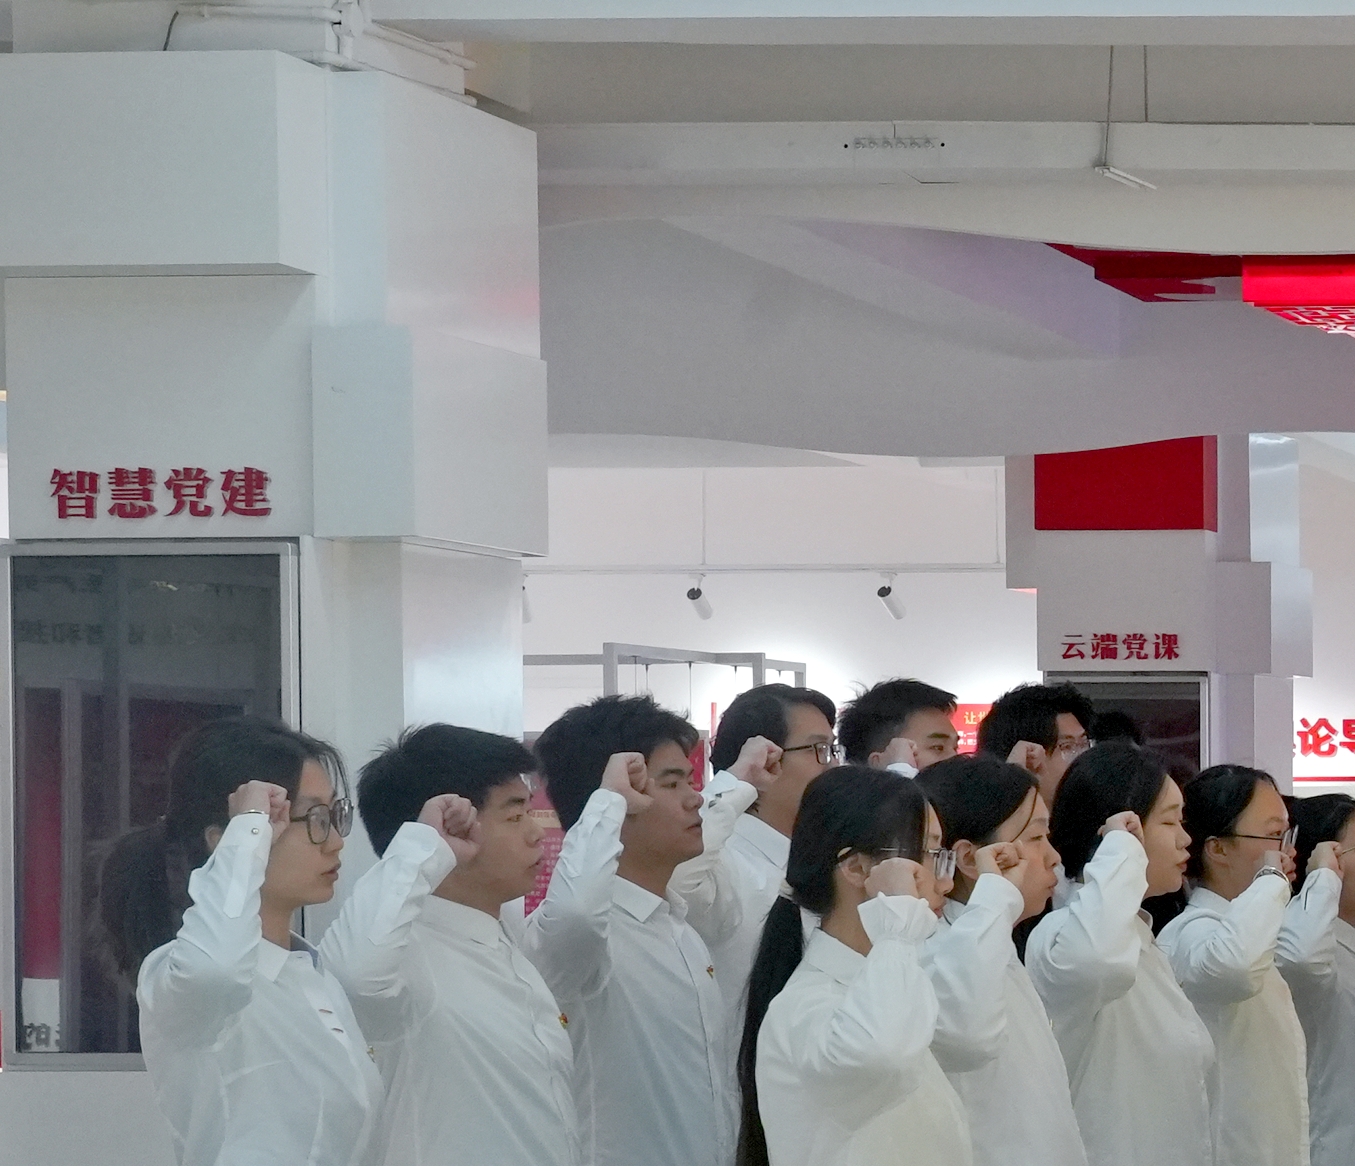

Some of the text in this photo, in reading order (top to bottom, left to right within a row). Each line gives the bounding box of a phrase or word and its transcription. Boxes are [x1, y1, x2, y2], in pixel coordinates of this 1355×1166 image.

[50, 466, 272, 519] 智慧党建
[1061, 633, 1180, 660] 云端党课
